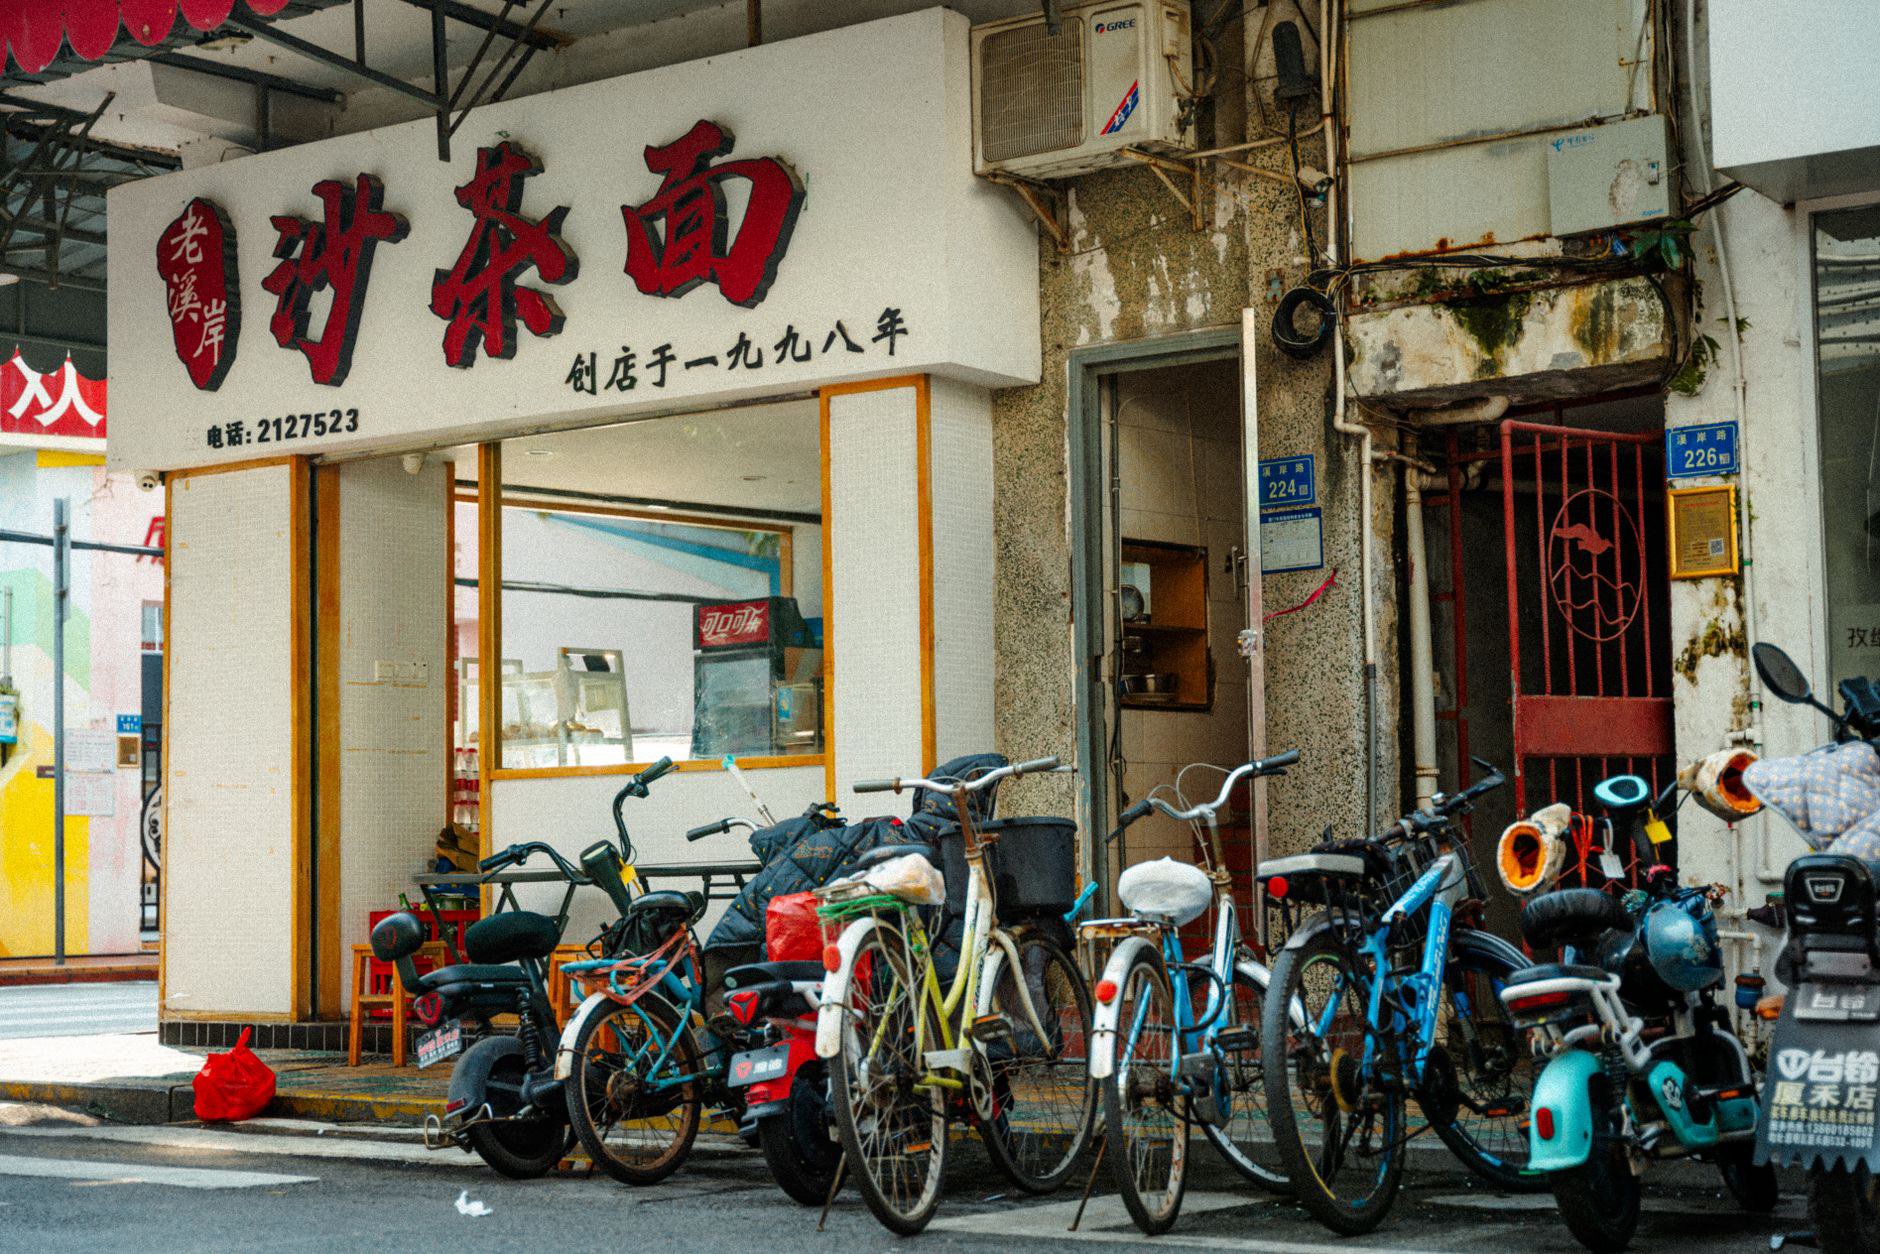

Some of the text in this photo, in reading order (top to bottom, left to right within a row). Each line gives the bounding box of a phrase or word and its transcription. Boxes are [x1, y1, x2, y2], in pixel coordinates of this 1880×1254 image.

[1106, 18, 1136, 32] GREE
[262, 119, 806, 388] 沙茶面
[168, 205, 228, 366] 老溪岸
[565, 307, 908, 395] 创店于一九九八年
[257, 408, 359, 443] 2127523
[1684, 447, 1717, 469] 226
[1268, 479, 1296, 499] 224
[702, 606, 766, 641] 可口可乐
[1807, 1049, 1880, 1084] 台铃
